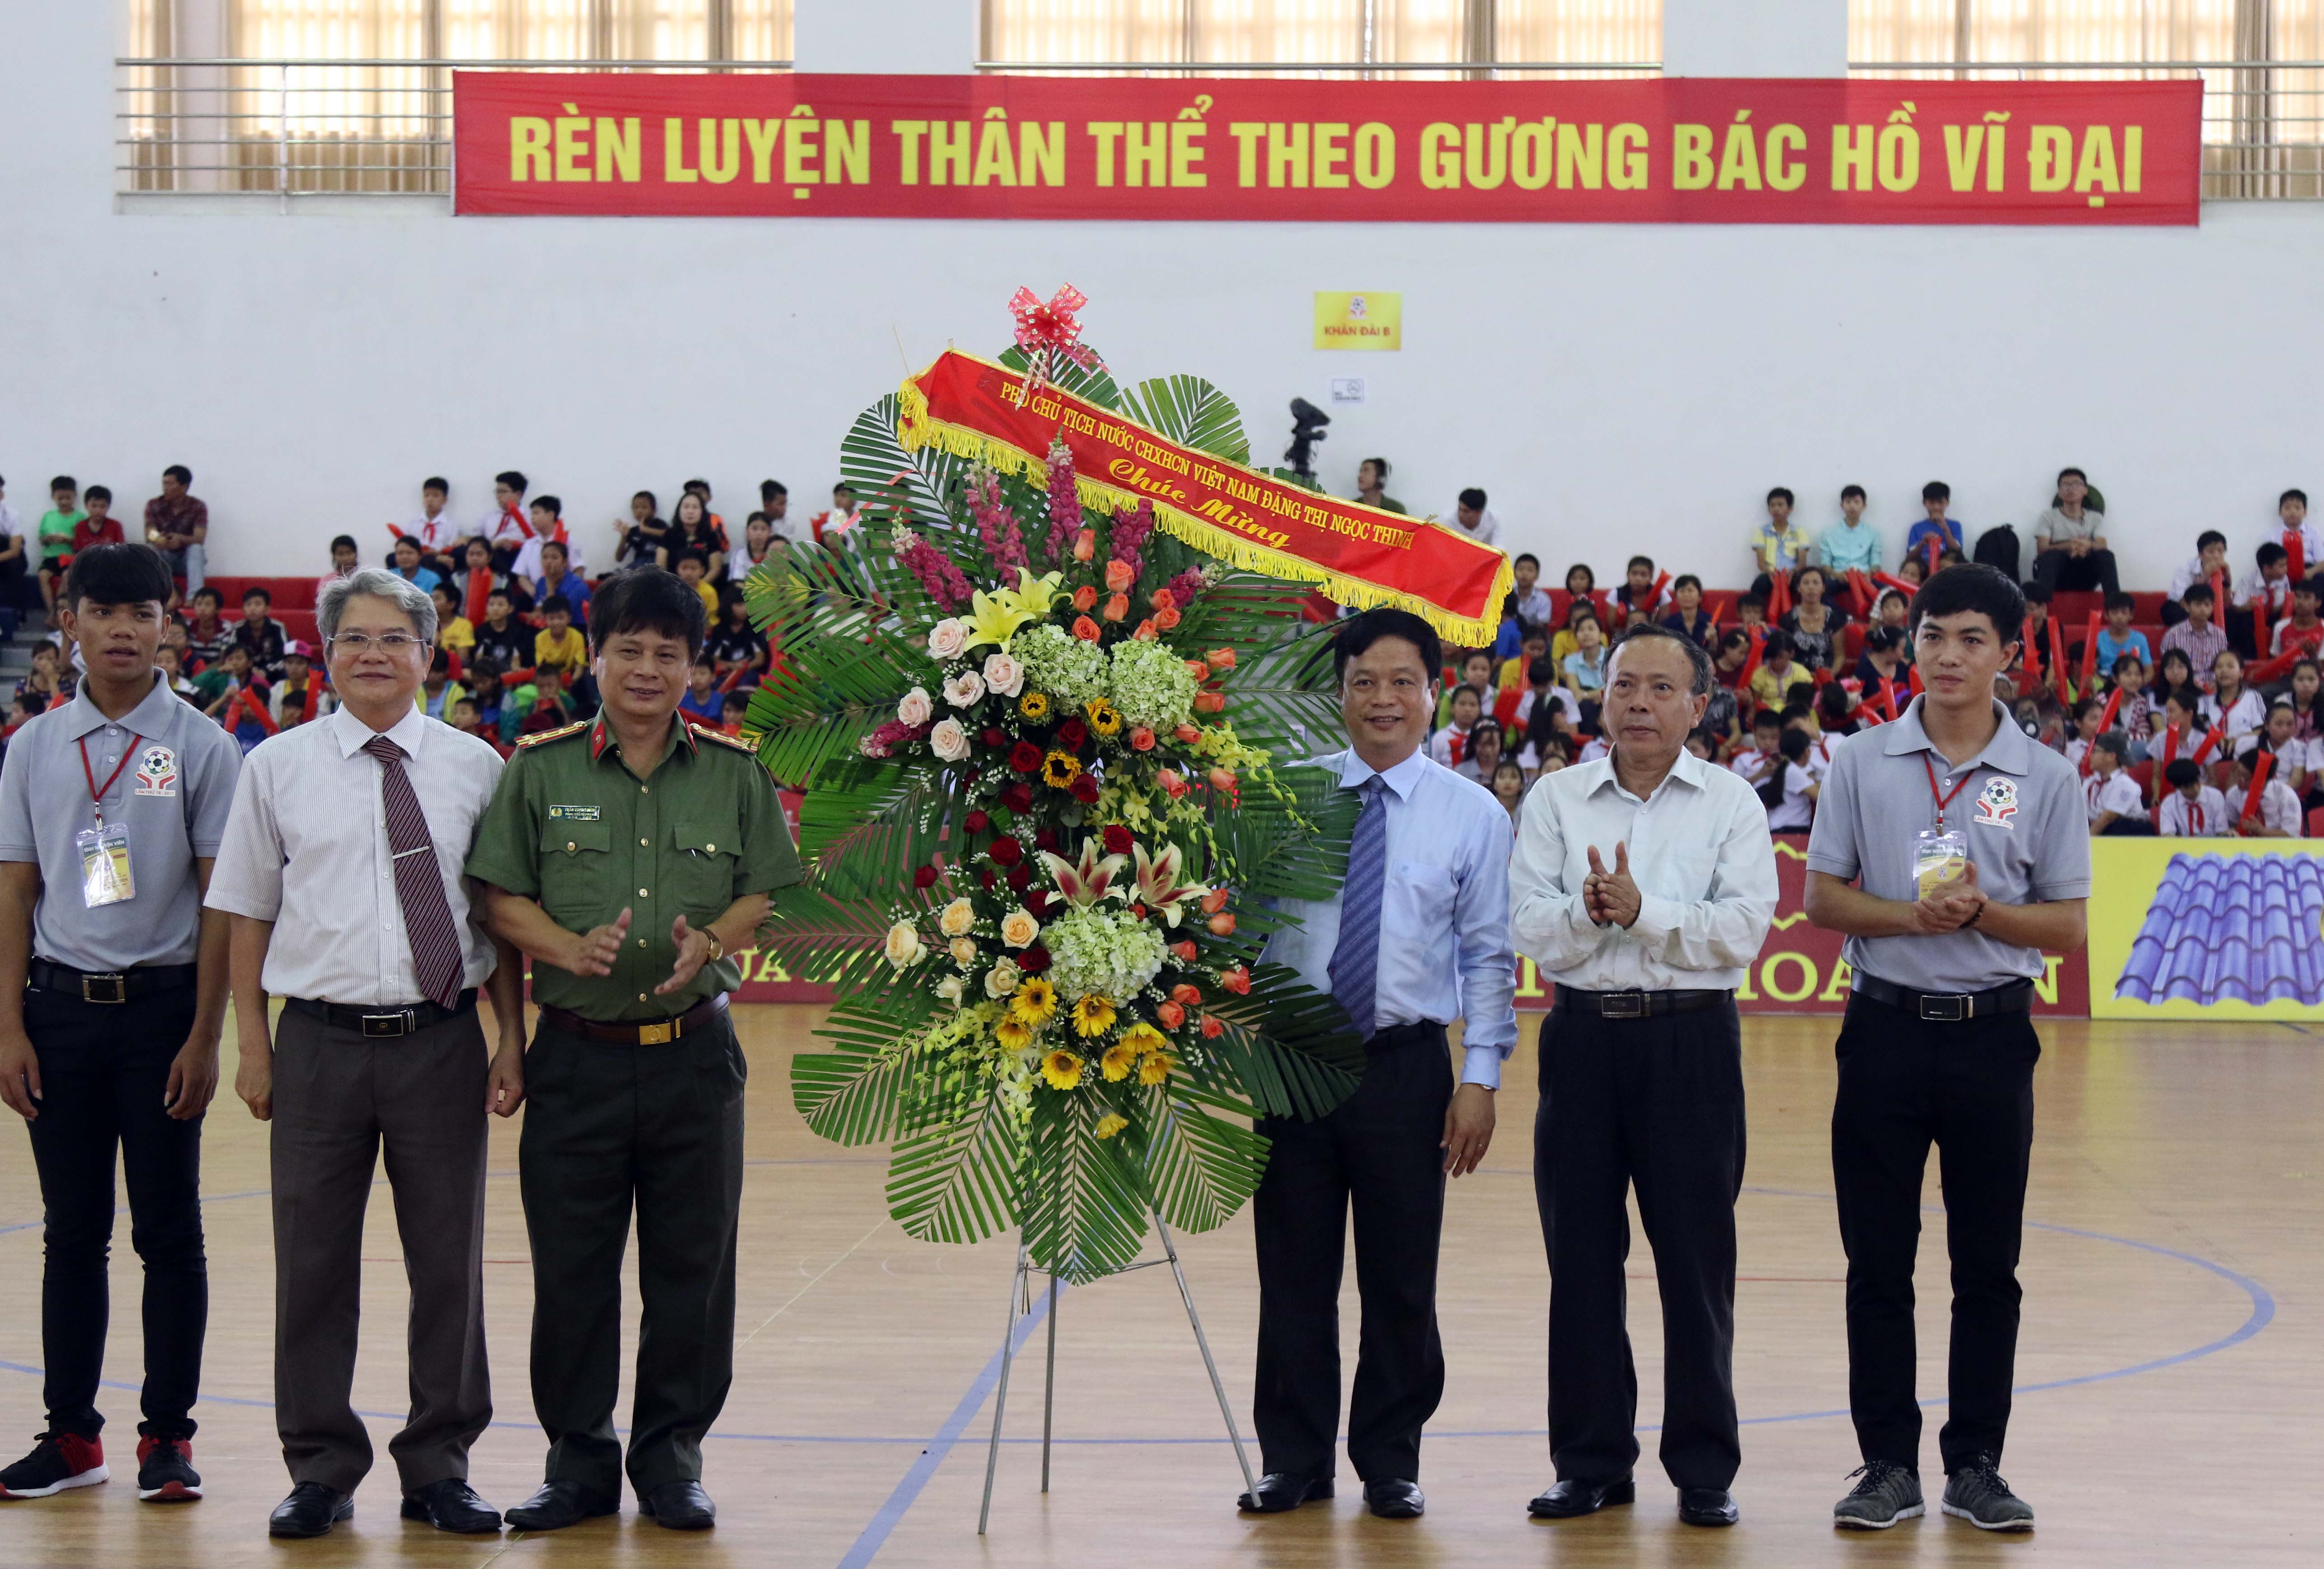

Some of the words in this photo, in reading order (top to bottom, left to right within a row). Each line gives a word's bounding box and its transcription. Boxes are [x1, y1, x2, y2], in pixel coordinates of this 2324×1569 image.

[510, 102, 641, 182] RÈN
[665, 104, 870, 199] LUYỆN
[892, 107, 1065, 186] THÂN
[1088, 94, 1213, 187] THỂ
[1230, 122, 1395, 189] THEO
[1420, 116, 1649, 190] GƯƠNG
[1673, 109, 1807, 191] BÁC
[1831, 101, 1920, 192] HỒ
[1944, 112, 2011, 192] VĨ
[2027, 125, 2143, 207] ĐẠI
[1383, 327, 1390, 335] B
[1032, 394, 1062, 421] CHỦ
[1062, 407, 1097, 436] TỊCH
[1096, 421, 1135, 451] NƯỚC
[1135, 439, 1192, 476] CHXHCN
[1194, 463, 1226, 491] VIỆT
[1226, 477, 1261, 504] NAM
[1260, 490, 1301, 520] ĐẶNG
[1303, 505, 1329, 532] THỊ
[1329, 514, 1371, 542] NGỌC
[1372, 524, 1415, 551] THỊNH
[1109, 458, 1187, 504] Chúc
[1190, 498, 1291, 548] Mừng
